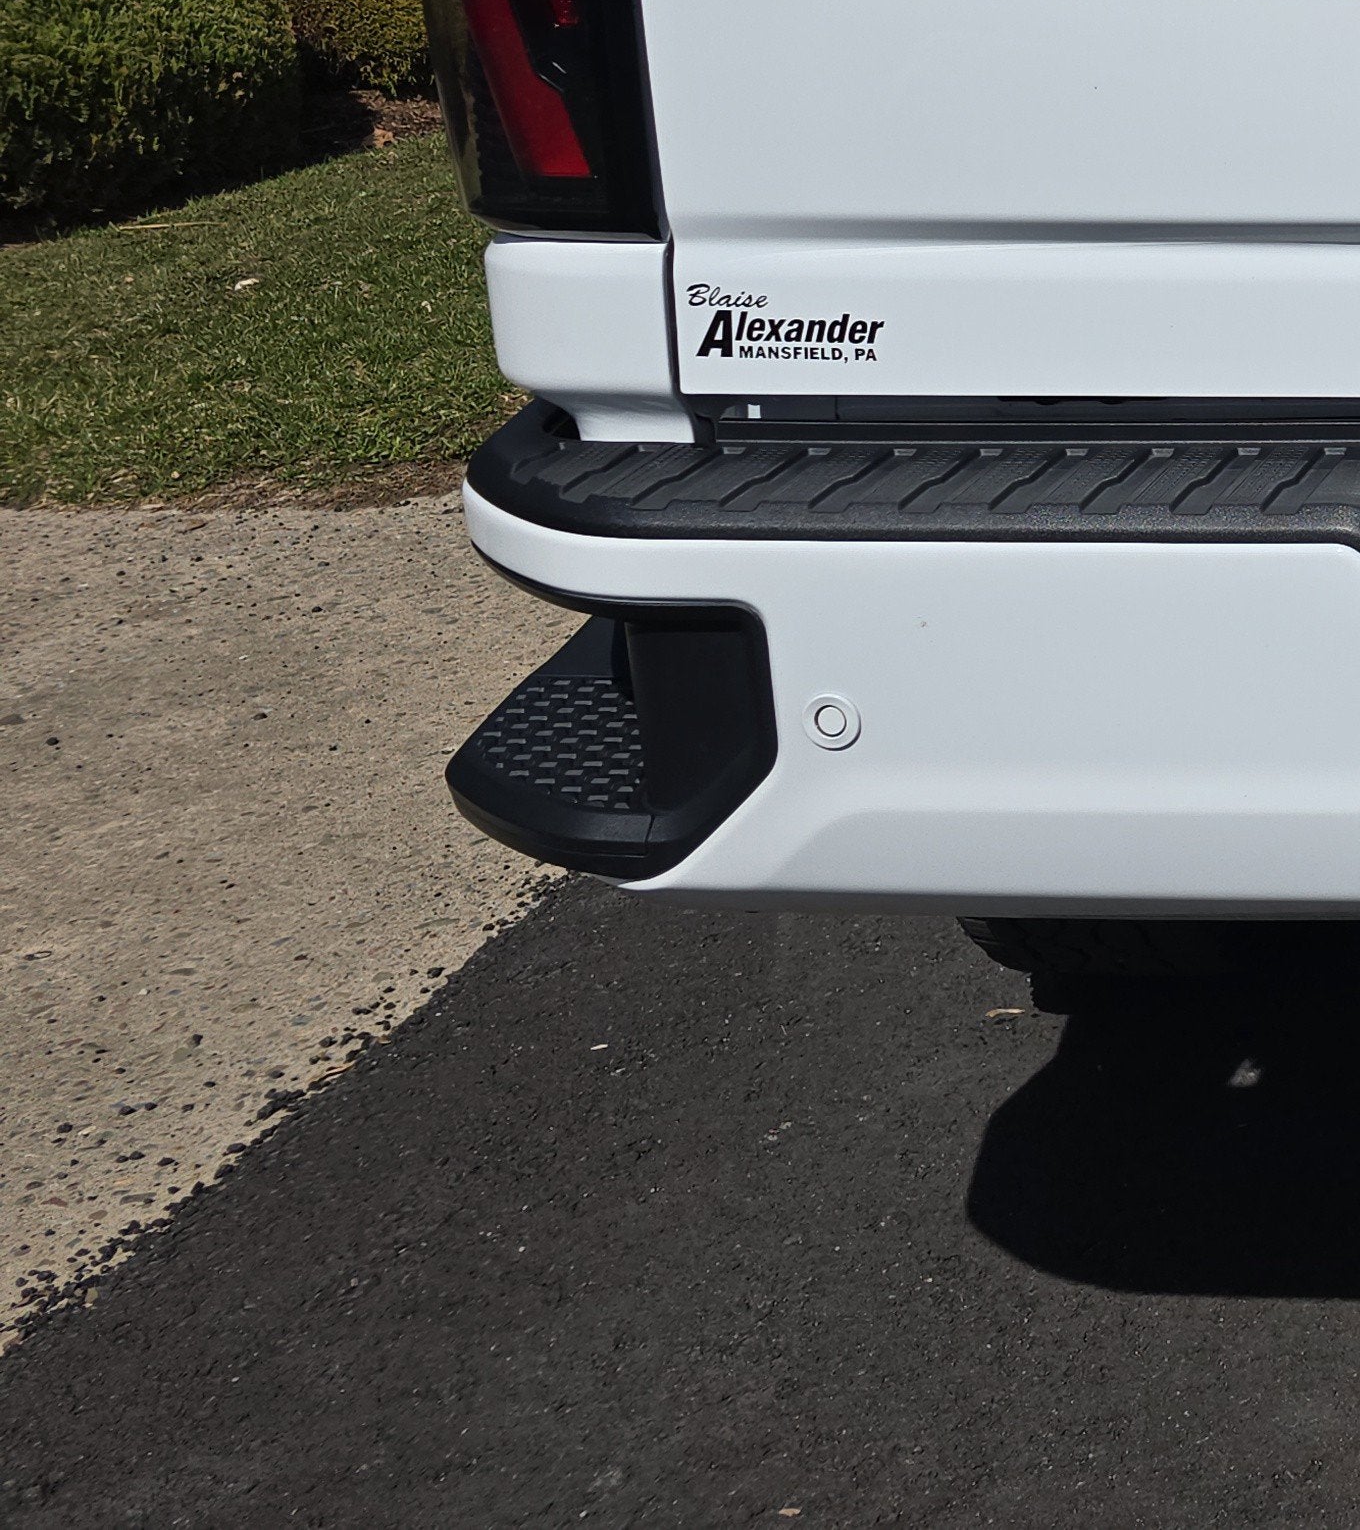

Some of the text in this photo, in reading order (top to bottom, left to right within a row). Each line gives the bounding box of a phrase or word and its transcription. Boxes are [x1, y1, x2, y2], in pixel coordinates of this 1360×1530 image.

[686, 283, 769, 308] Blaise
[696, 309, 885, 358] Alexander
[739, 345, 878, 364] MANSFIELD, PA
